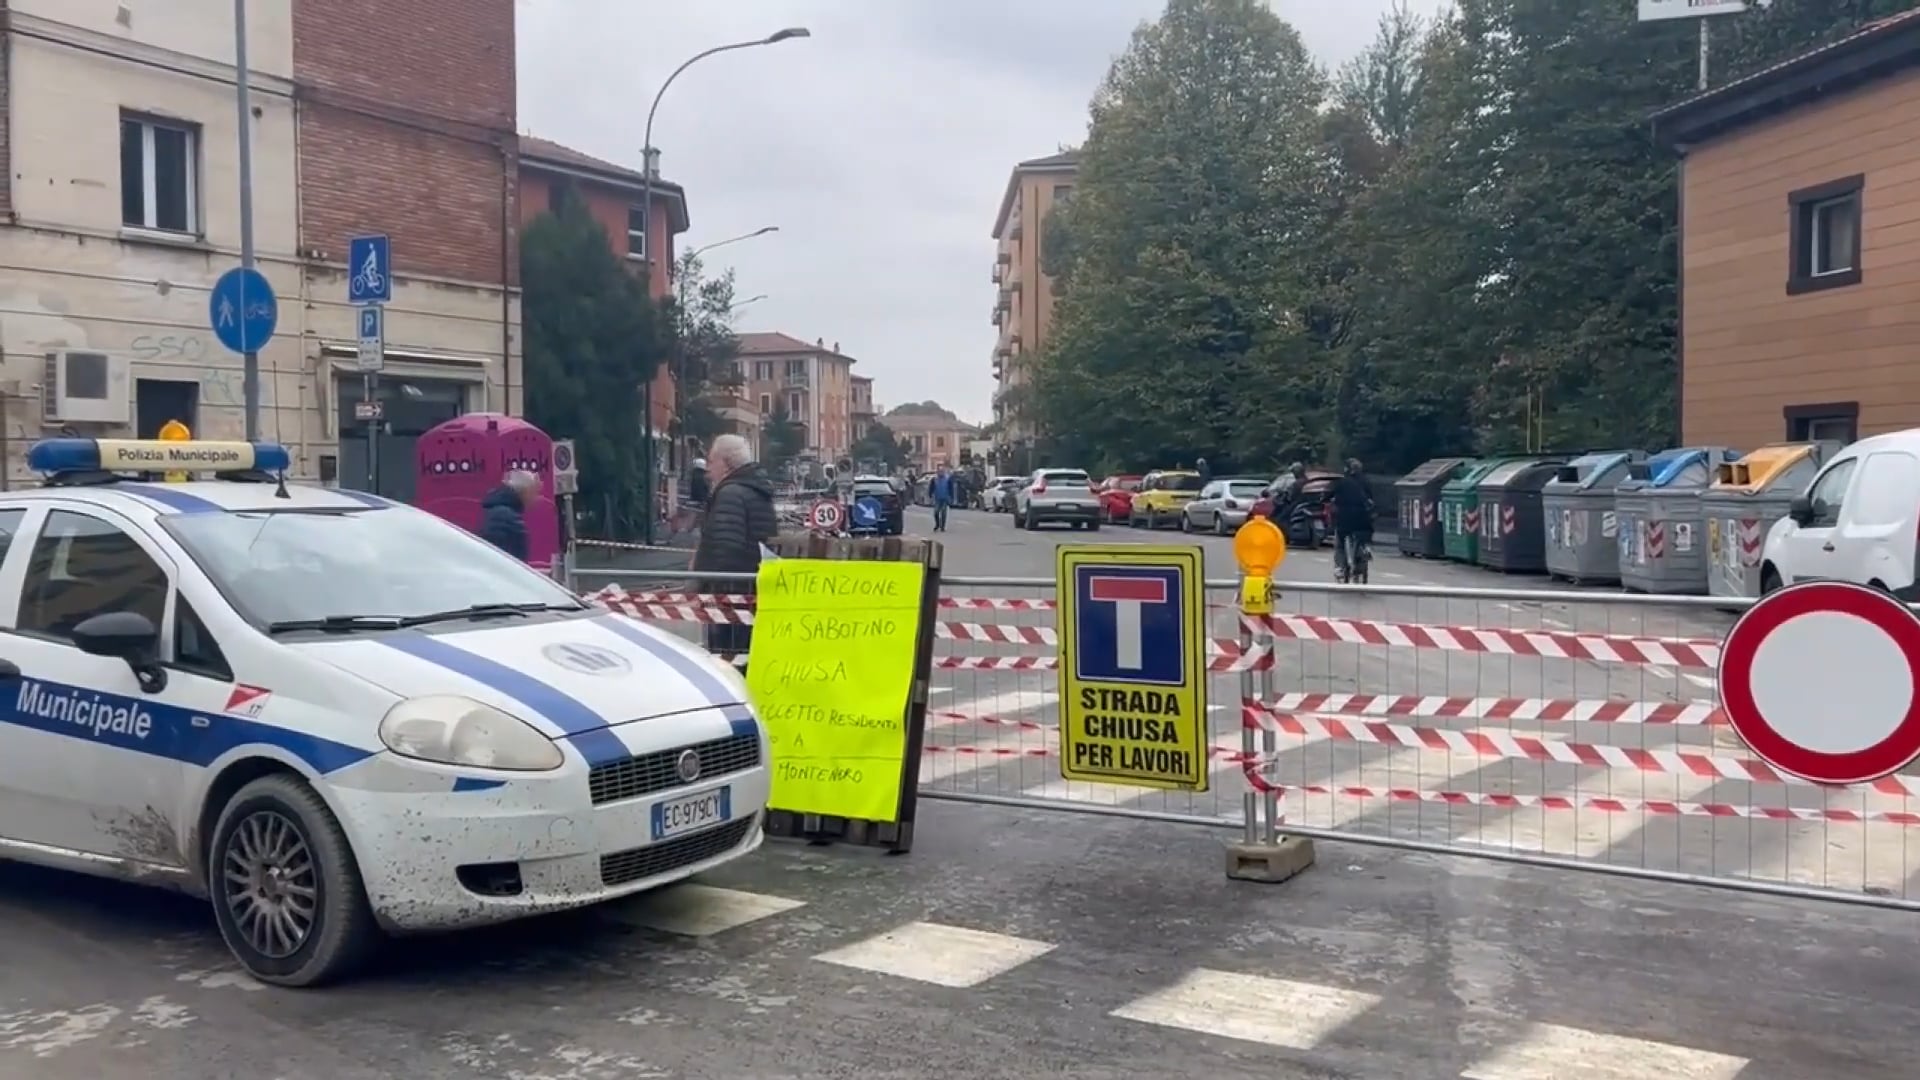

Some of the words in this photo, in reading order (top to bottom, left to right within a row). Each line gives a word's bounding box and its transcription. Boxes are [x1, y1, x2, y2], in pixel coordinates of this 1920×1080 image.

[118, 448, 163, 460] Polizia
[169, 449, 239, 463] Municipale
[818, 507, 836, 522] 30
[775, 569, 898, 597] ATTENZIONE
[771, 621, 792, 639] VIA
[800, 614, 896, 642] SABOTINO
[762, 660, 847, 695] CHIUSA
[16, 681, 152, 739] Municipale
[1081, 688, 1181, 716] STRADA
[793, 733, 804, 748] A
[1084, 715, 1179, 744] CHIUSA
[1075, 742, 1113, 768] PER
[1120, 745, 1191, 775] LAVORI
